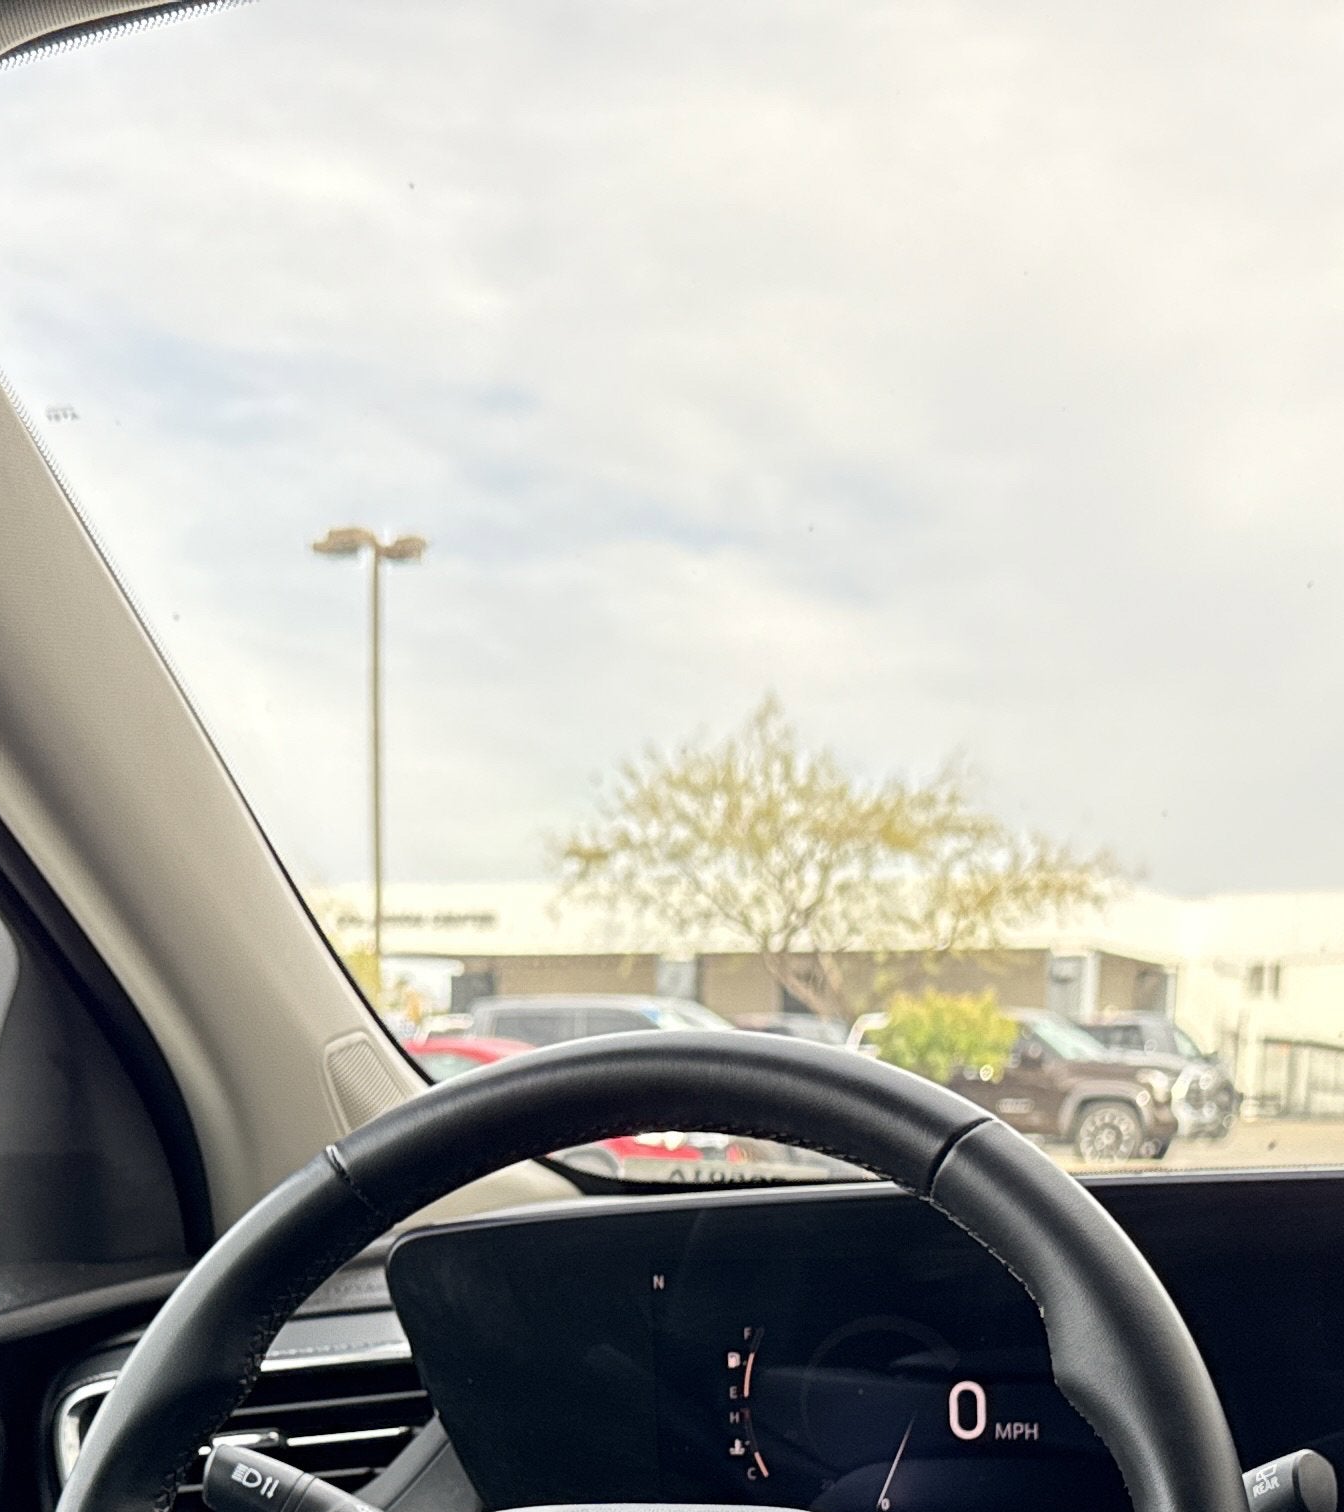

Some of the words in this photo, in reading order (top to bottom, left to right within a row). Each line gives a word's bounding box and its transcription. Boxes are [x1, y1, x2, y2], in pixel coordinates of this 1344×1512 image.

[652, 1274, 665, 1290] N
[743, 1326, 752, 1341] F
[729, 1385, 738, 1399] E
[729, 1411, 740, 1424] H
[949, 1380, 987, 1440] 0
[995, 1422, 1040, 1440] MPH
[747, 1466, 757, 1480] C
[1252, 1476, 1281, 1497] REAR
